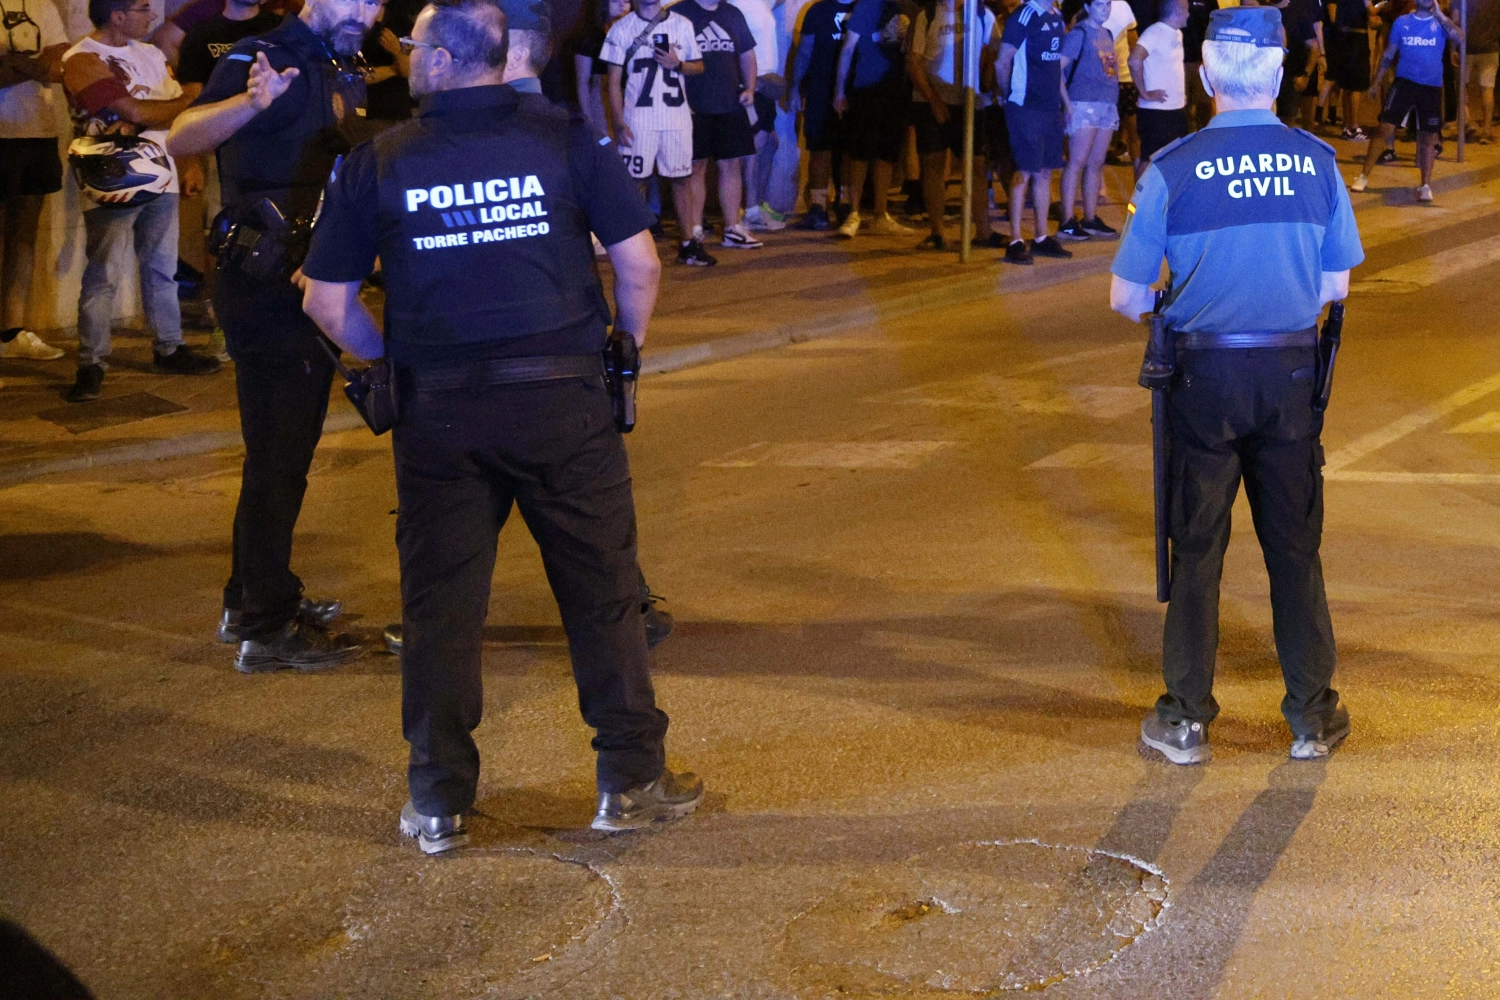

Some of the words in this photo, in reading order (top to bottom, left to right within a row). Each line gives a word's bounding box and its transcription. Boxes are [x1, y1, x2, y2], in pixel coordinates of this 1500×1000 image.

[623, 154, 643, 174] 79
[1195, 153, 1316, 180] GUARDIA
[406, 175, 545, 212] POLICIA
[1227, 176, 1295, 199] CIVIL
[480, 201, 548, 224] LOCAL
[412, 232, 469, 250] TORRE
[472, 221, 550, 244] PACHECO
